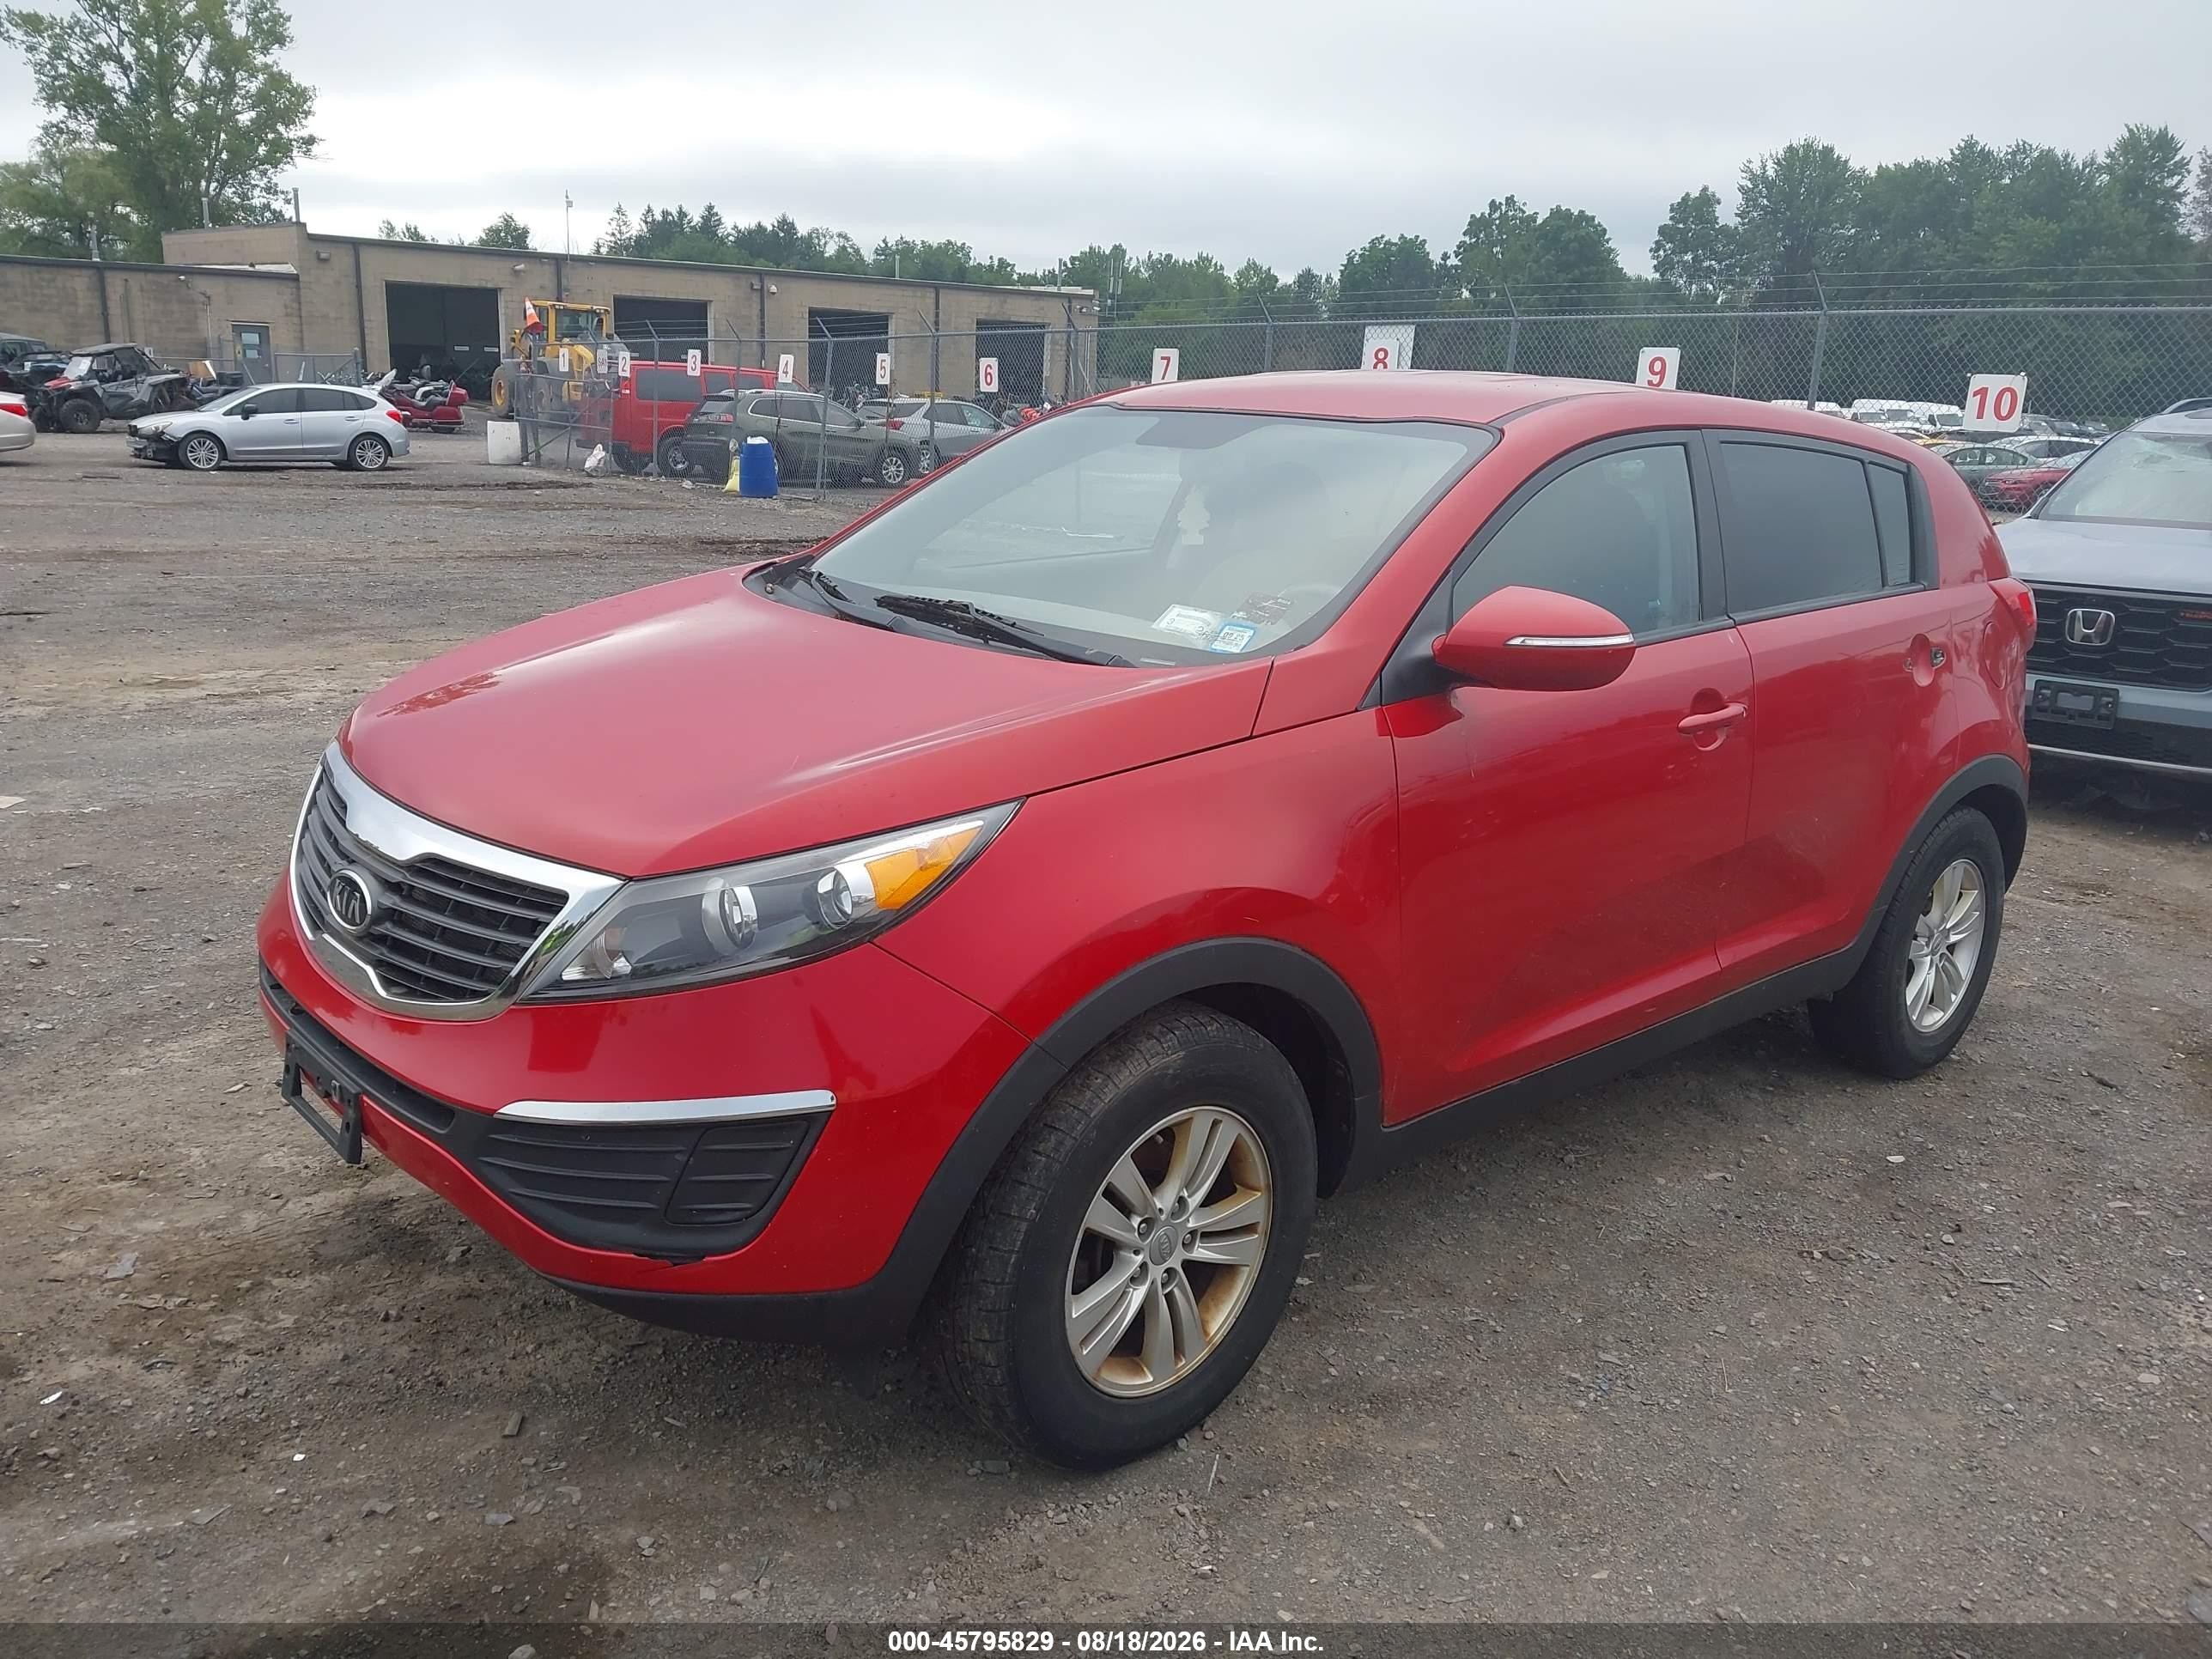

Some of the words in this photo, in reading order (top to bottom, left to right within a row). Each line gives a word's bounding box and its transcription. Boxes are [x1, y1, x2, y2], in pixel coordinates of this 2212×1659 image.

[621, 356, 628, 372] 2
[690, 354, 697, 371] 3
[781, 359, 789, 378] 4
[879, 359, 886, 379] 5
[1160, 356, 1171, 380] 7
[1372, 347, 1389, 370] 8
[984, 363, 994, 386] 6
[1647, 356, 1667, 388] 9
[1972, 386, 2019, 422] 10
[332, 878, 361, 924] KIA
